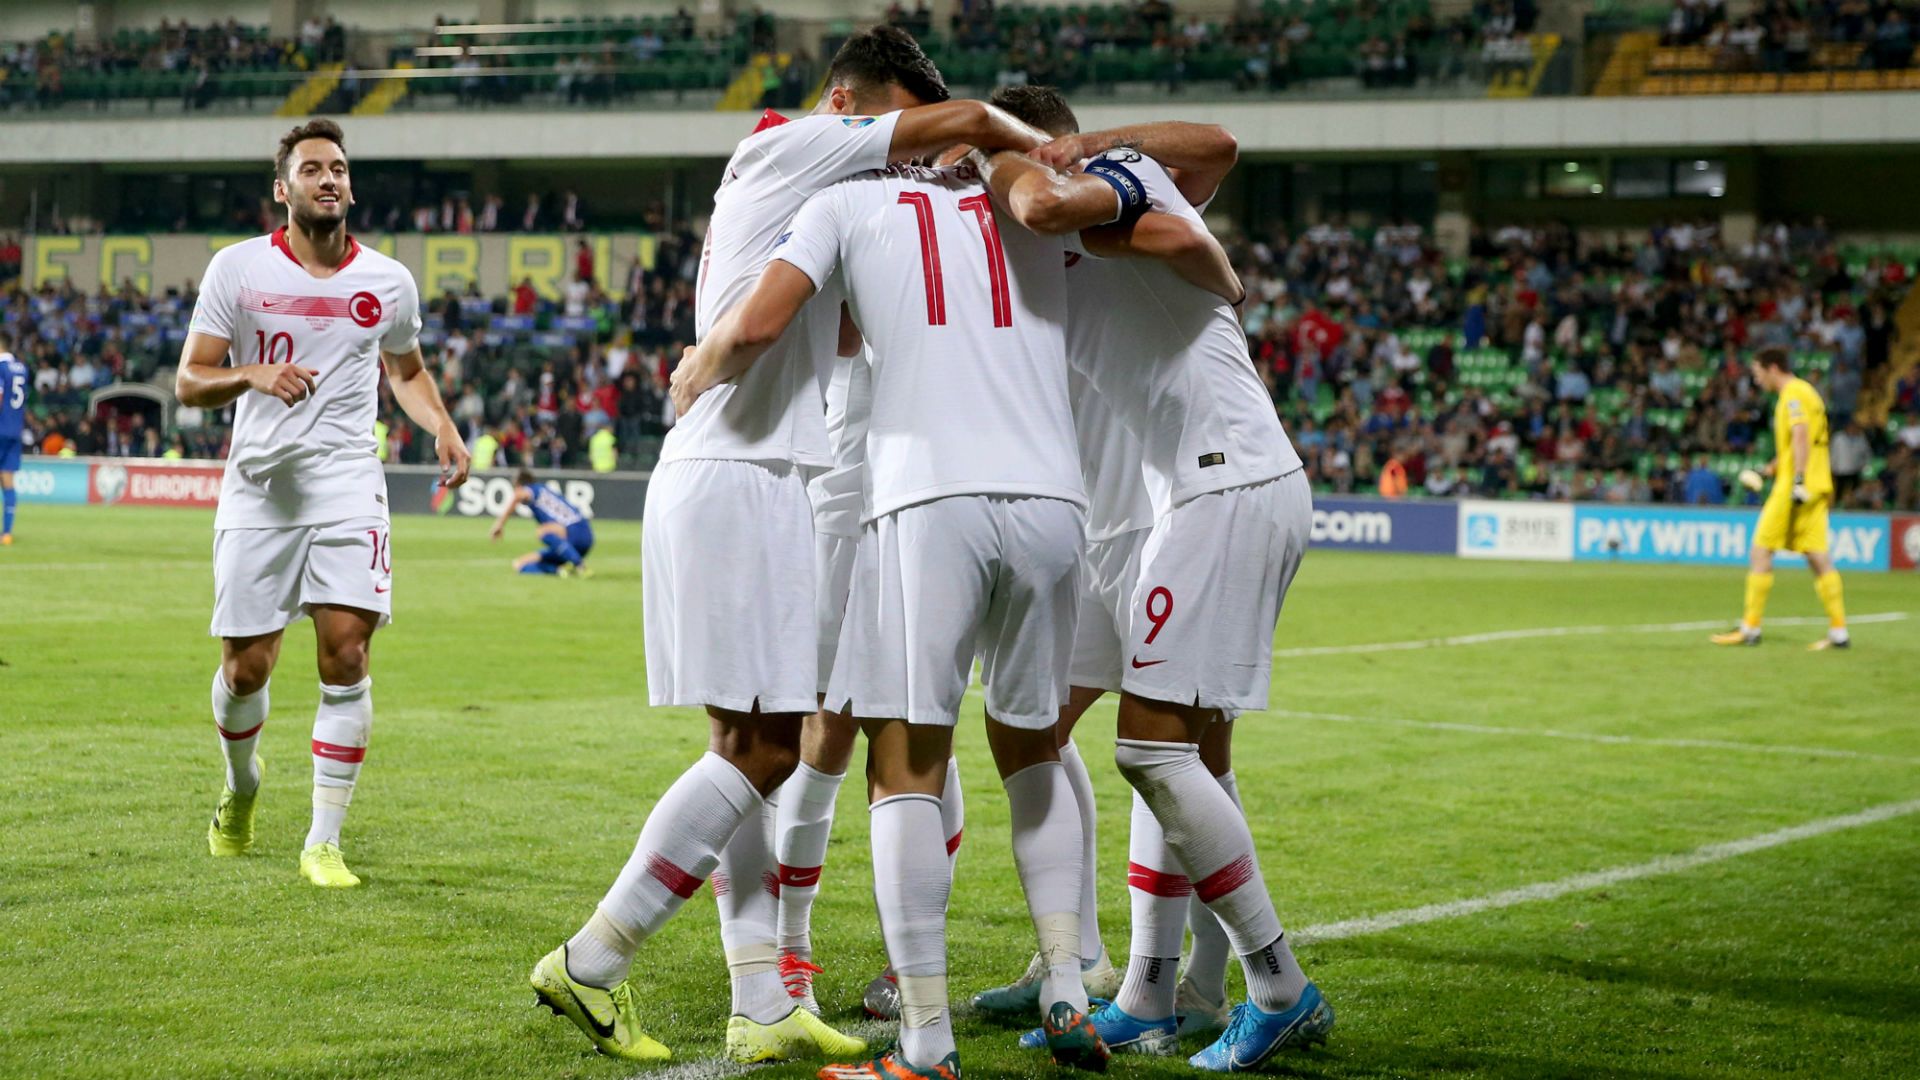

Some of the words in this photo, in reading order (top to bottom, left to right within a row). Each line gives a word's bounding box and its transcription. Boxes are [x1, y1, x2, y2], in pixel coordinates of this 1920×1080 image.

[1106, 169, 1139, 206] RESPEC
[35, 236, 151, 297] FC
[897, 191, 1013, 328] 11
[256, 329, 294, 365] 10
[10, 375, 26, 410] 5
[13, 469, 56, 495] 020
[130, 473, 224, 501] EUROPEA
[1579, 517, 1646, 554] PAY
[1652, 520, 1746, 557] WITH
[1144, 586, 1173, 645] 9
